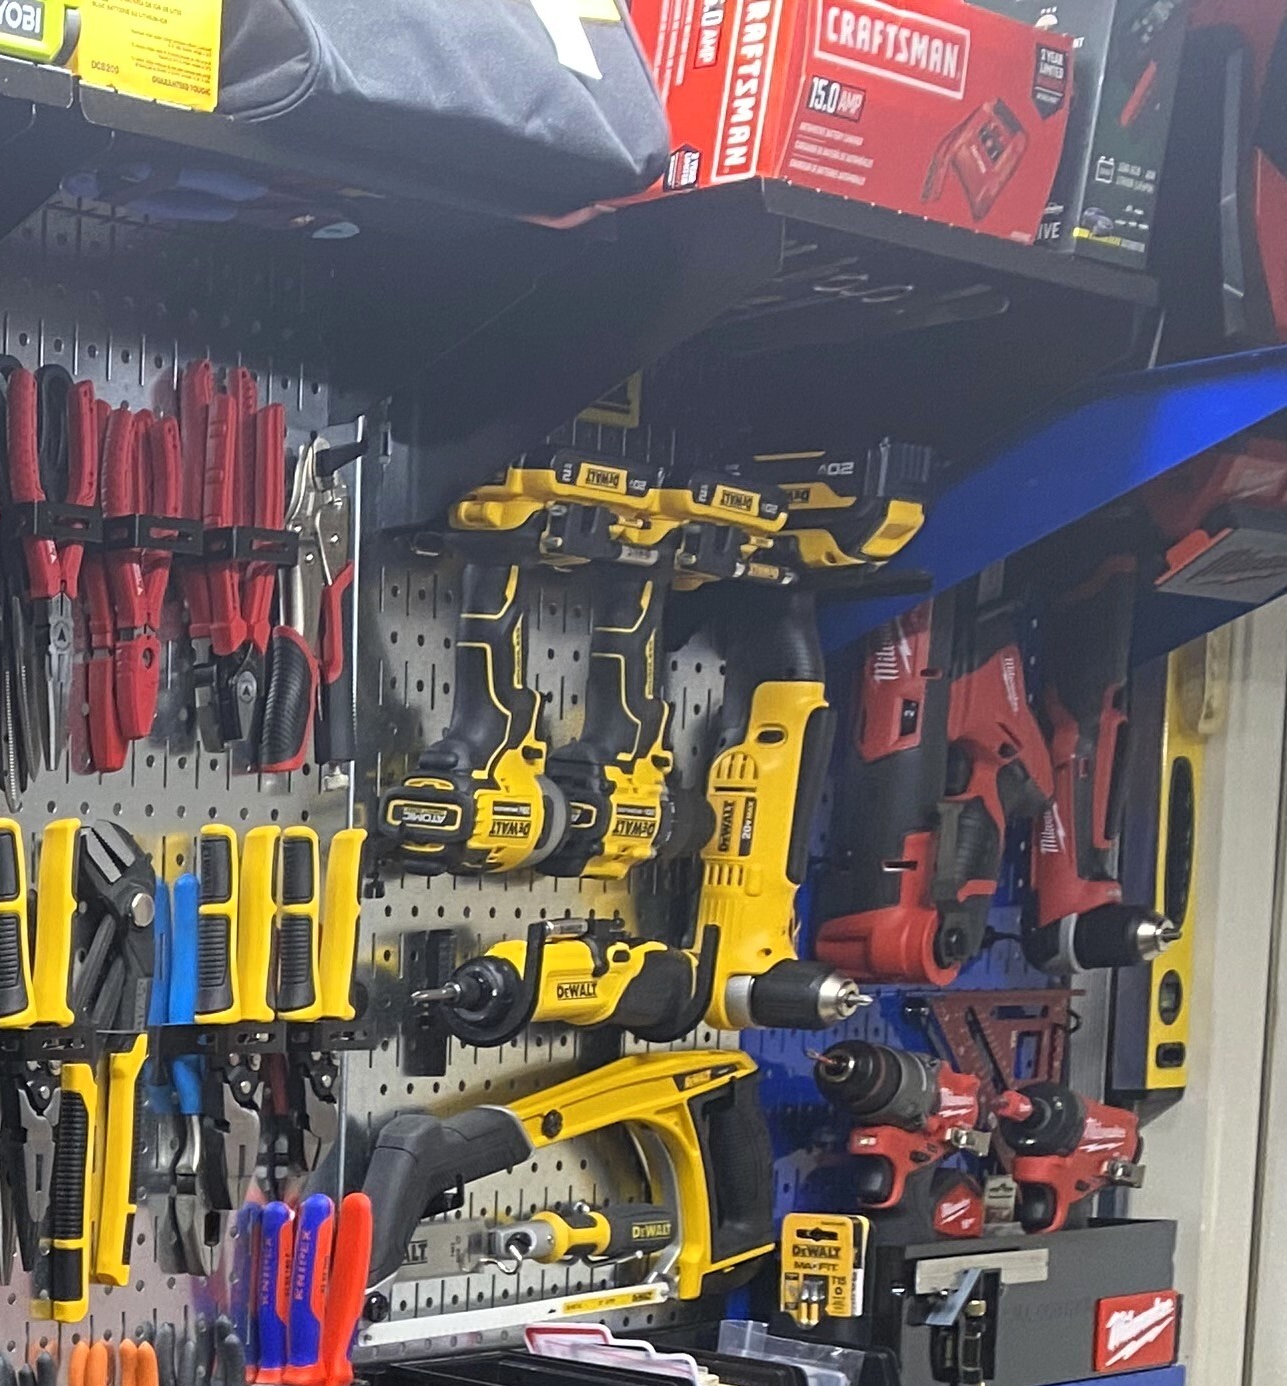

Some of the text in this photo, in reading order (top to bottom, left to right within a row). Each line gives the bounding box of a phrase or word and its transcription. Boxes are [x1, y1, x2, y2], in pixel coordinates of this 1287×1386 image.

[827, 6, 961, 79] CRAFTSMAN
[725, 0, 771, 166] RAFTSMAN
[810, 76, 863, 116] 15.0 AMP
[489, 819, 530, 838] DEWALT
[613, 819, 655, 837] DEWALT
[556, 982, 598, 999] DEWALT
[631, 1223, 672, 1239] DEWALT
[792, 1244, 842, 1258] DEWALT
